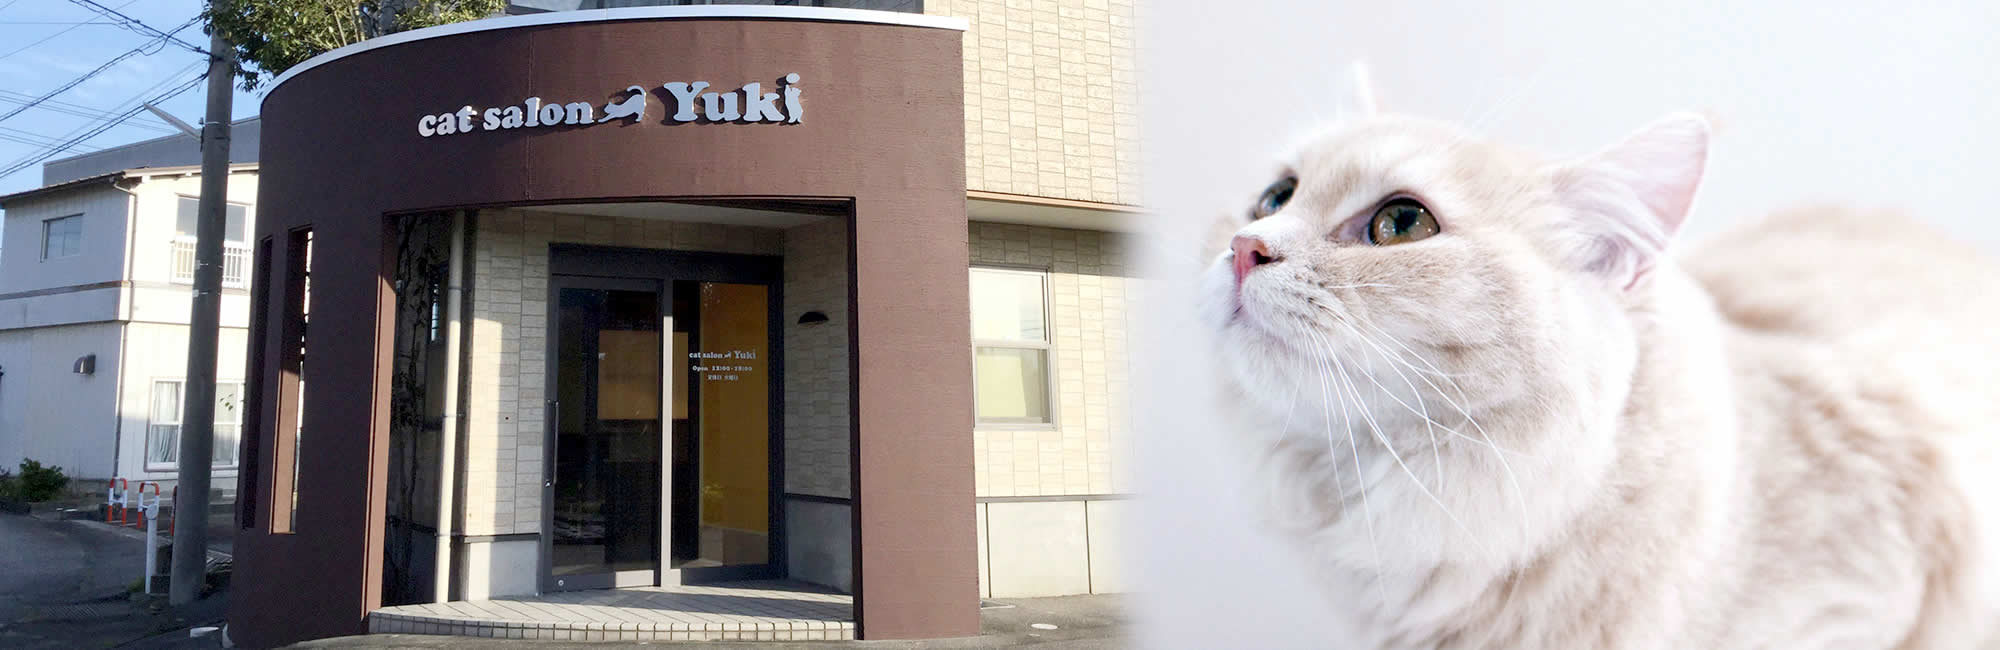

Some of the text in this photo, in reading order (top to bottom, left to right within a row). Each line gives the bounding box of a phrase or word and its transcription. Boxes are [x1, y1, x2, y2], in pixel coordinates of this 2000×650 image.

[418, 72, 803, 138] cat salon Yuki
[734, 348, 756, 359] Yuki
